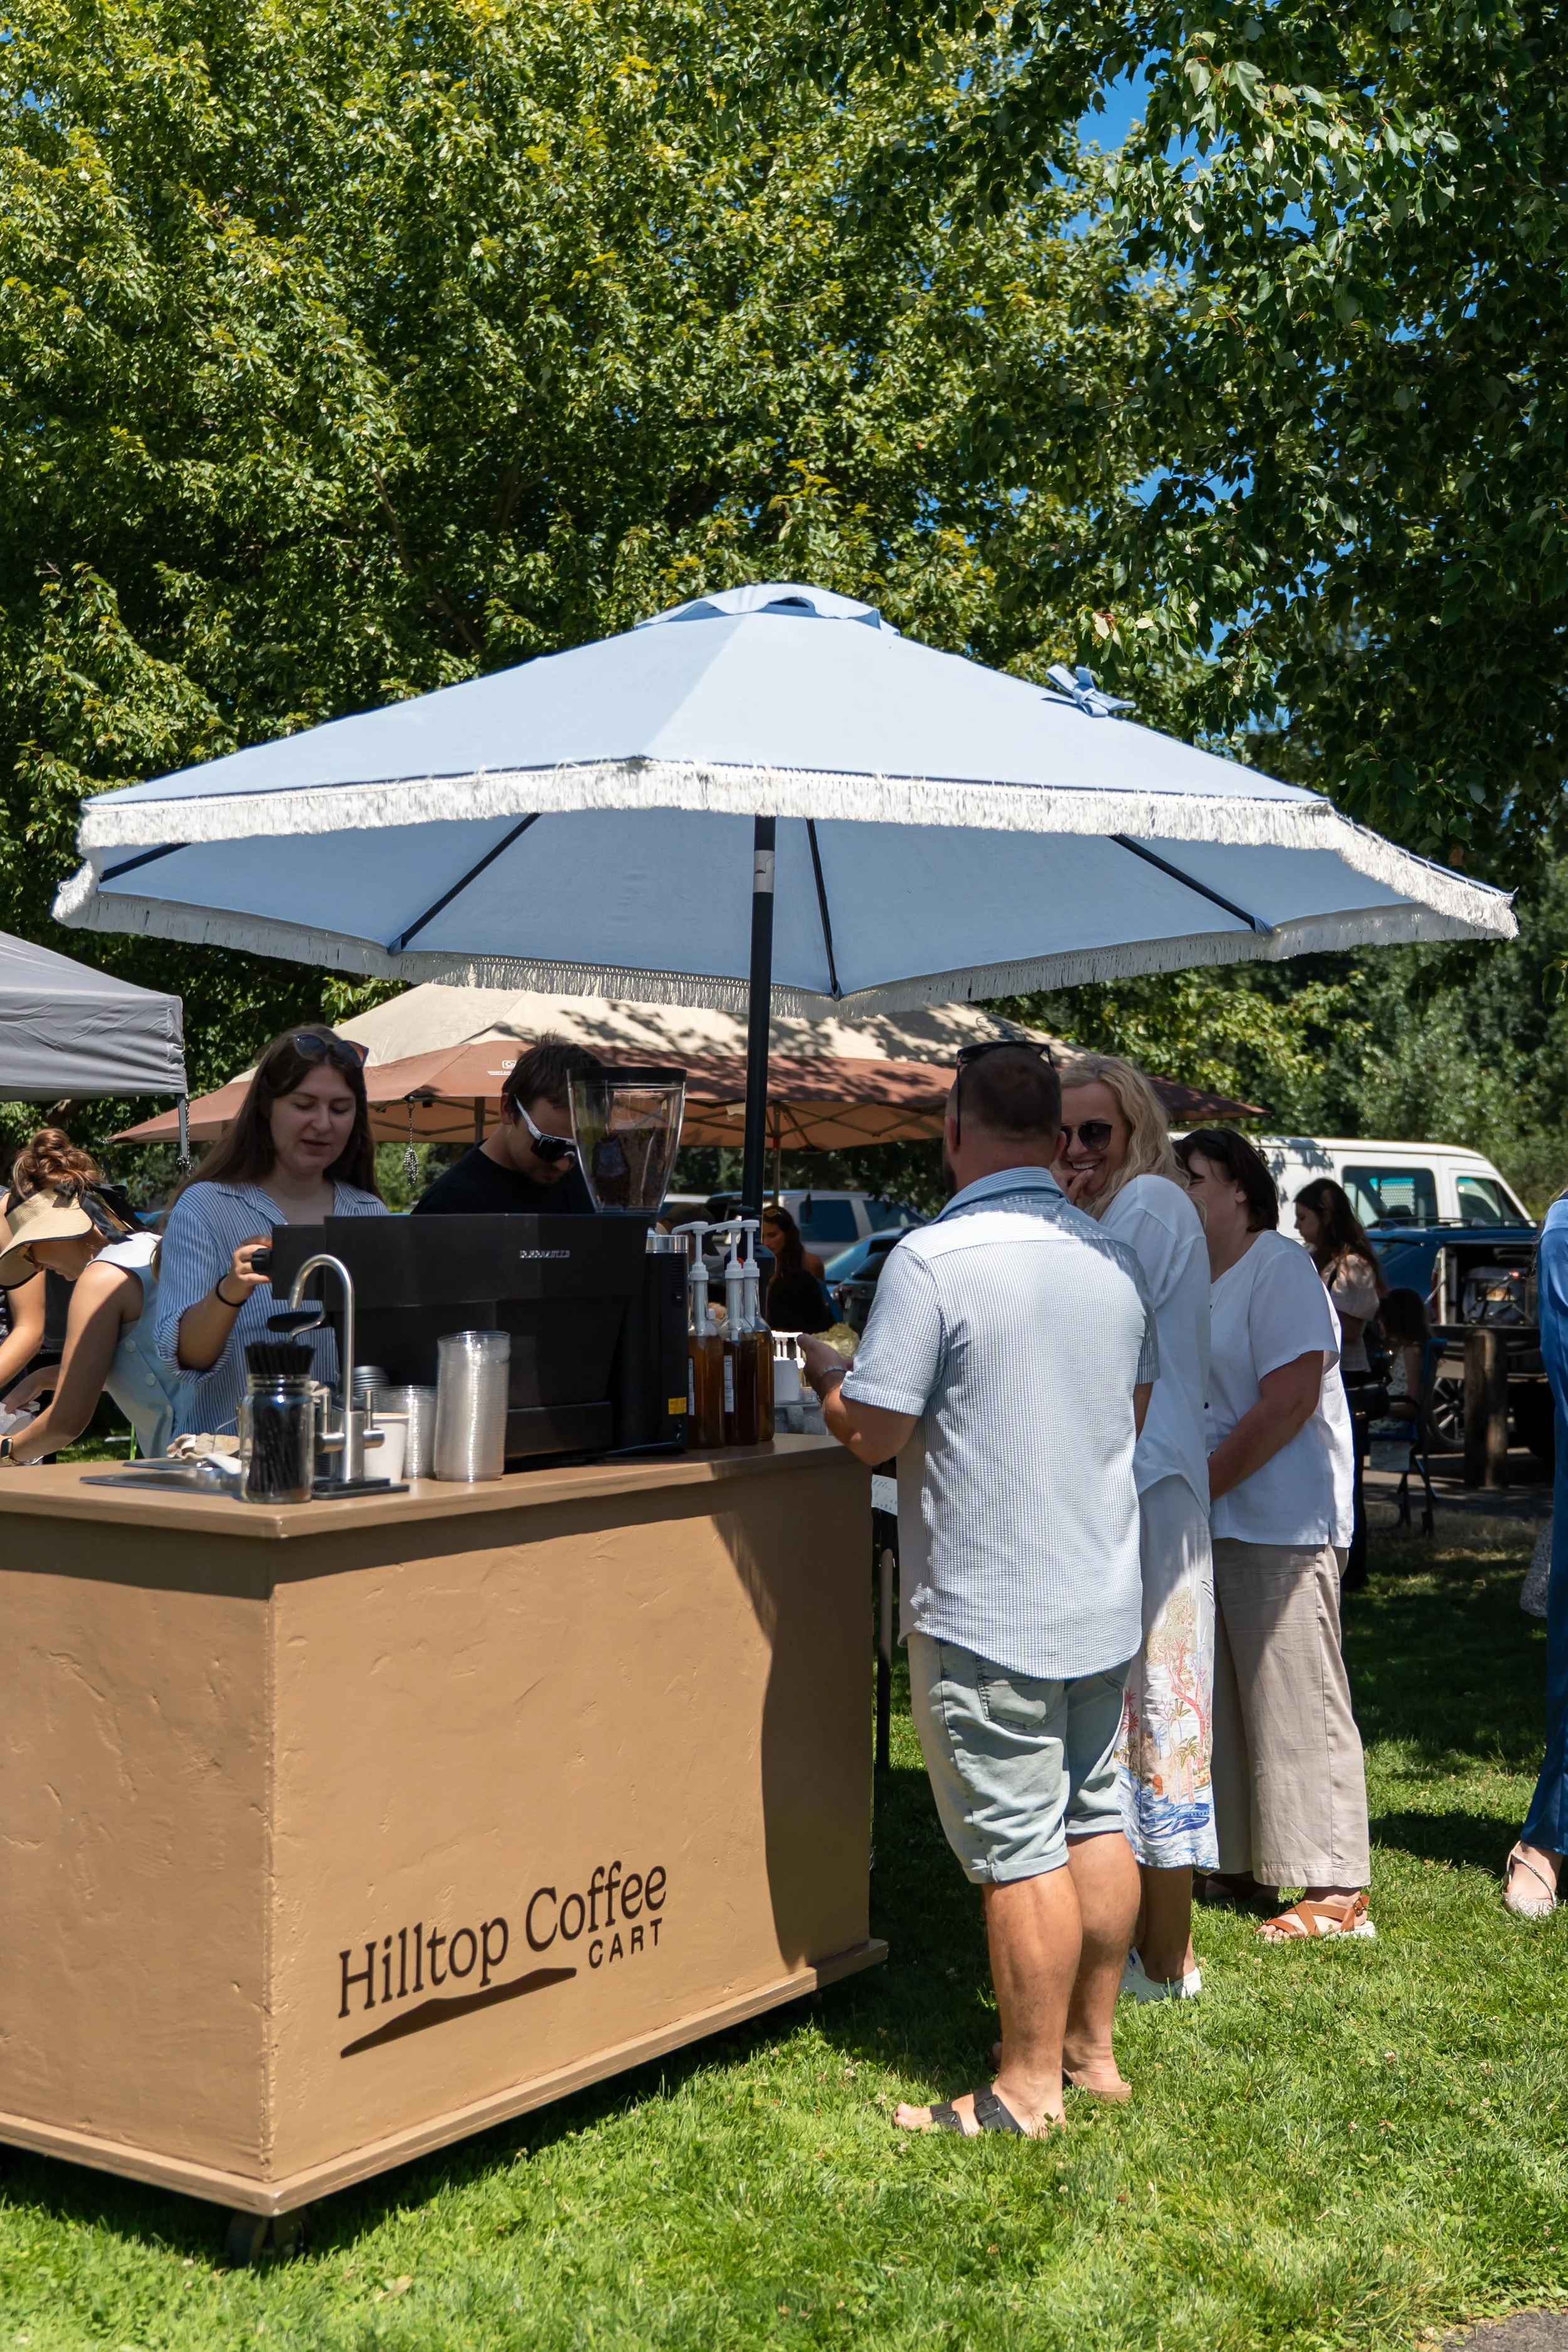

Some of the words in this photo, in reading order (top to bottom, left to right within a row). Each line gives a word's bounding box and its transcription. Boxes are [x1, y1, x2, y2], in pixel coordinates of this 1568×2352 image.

[338, 1917, 509, 2018] Hilltop
[526, 1860, 667, 1952] Coffee
[588, 1917, 663, 1969] CART
